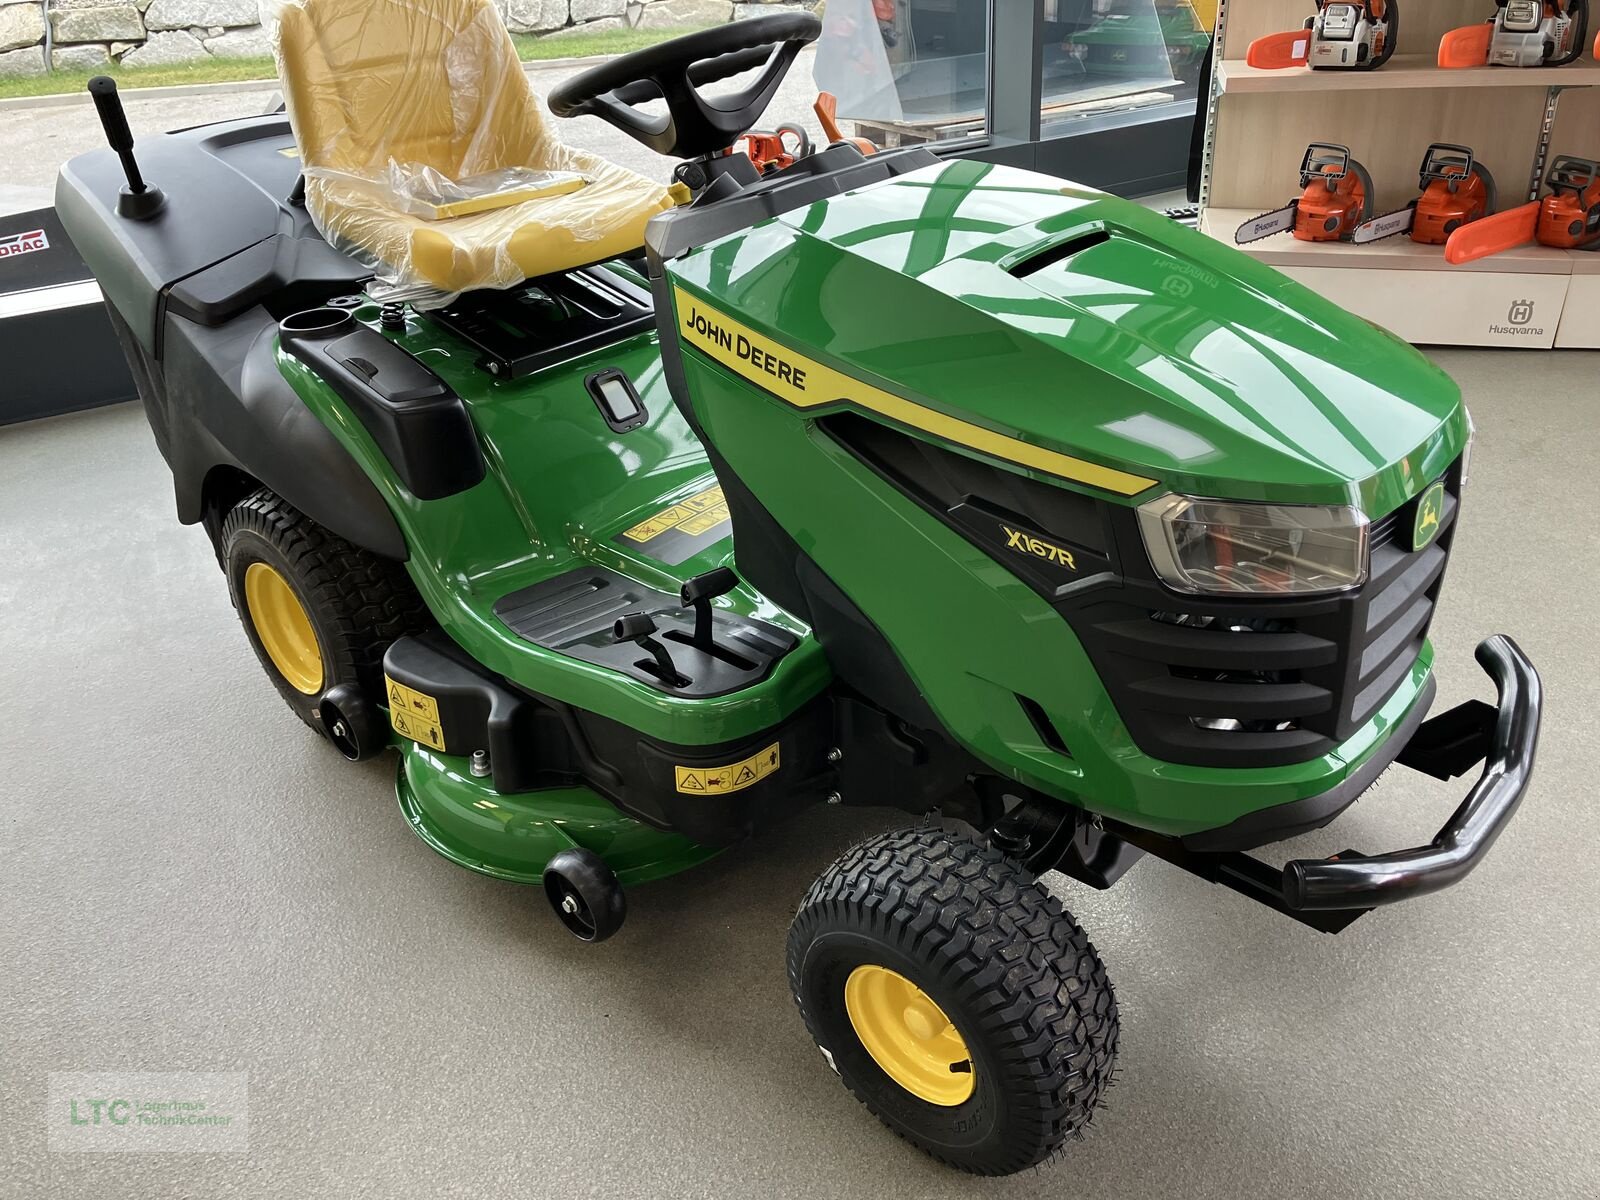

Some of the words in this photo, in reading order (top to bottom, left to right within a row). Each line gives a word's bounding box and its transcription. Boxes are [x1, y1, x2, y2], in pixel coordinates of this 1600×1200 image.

[686, 307, 732, 352] JOHN
[736, 333, 807, 391] DEERE
[1488, 324, 1544, 336] Husqvarna
[1003, 526, 1077, 570] X167R
